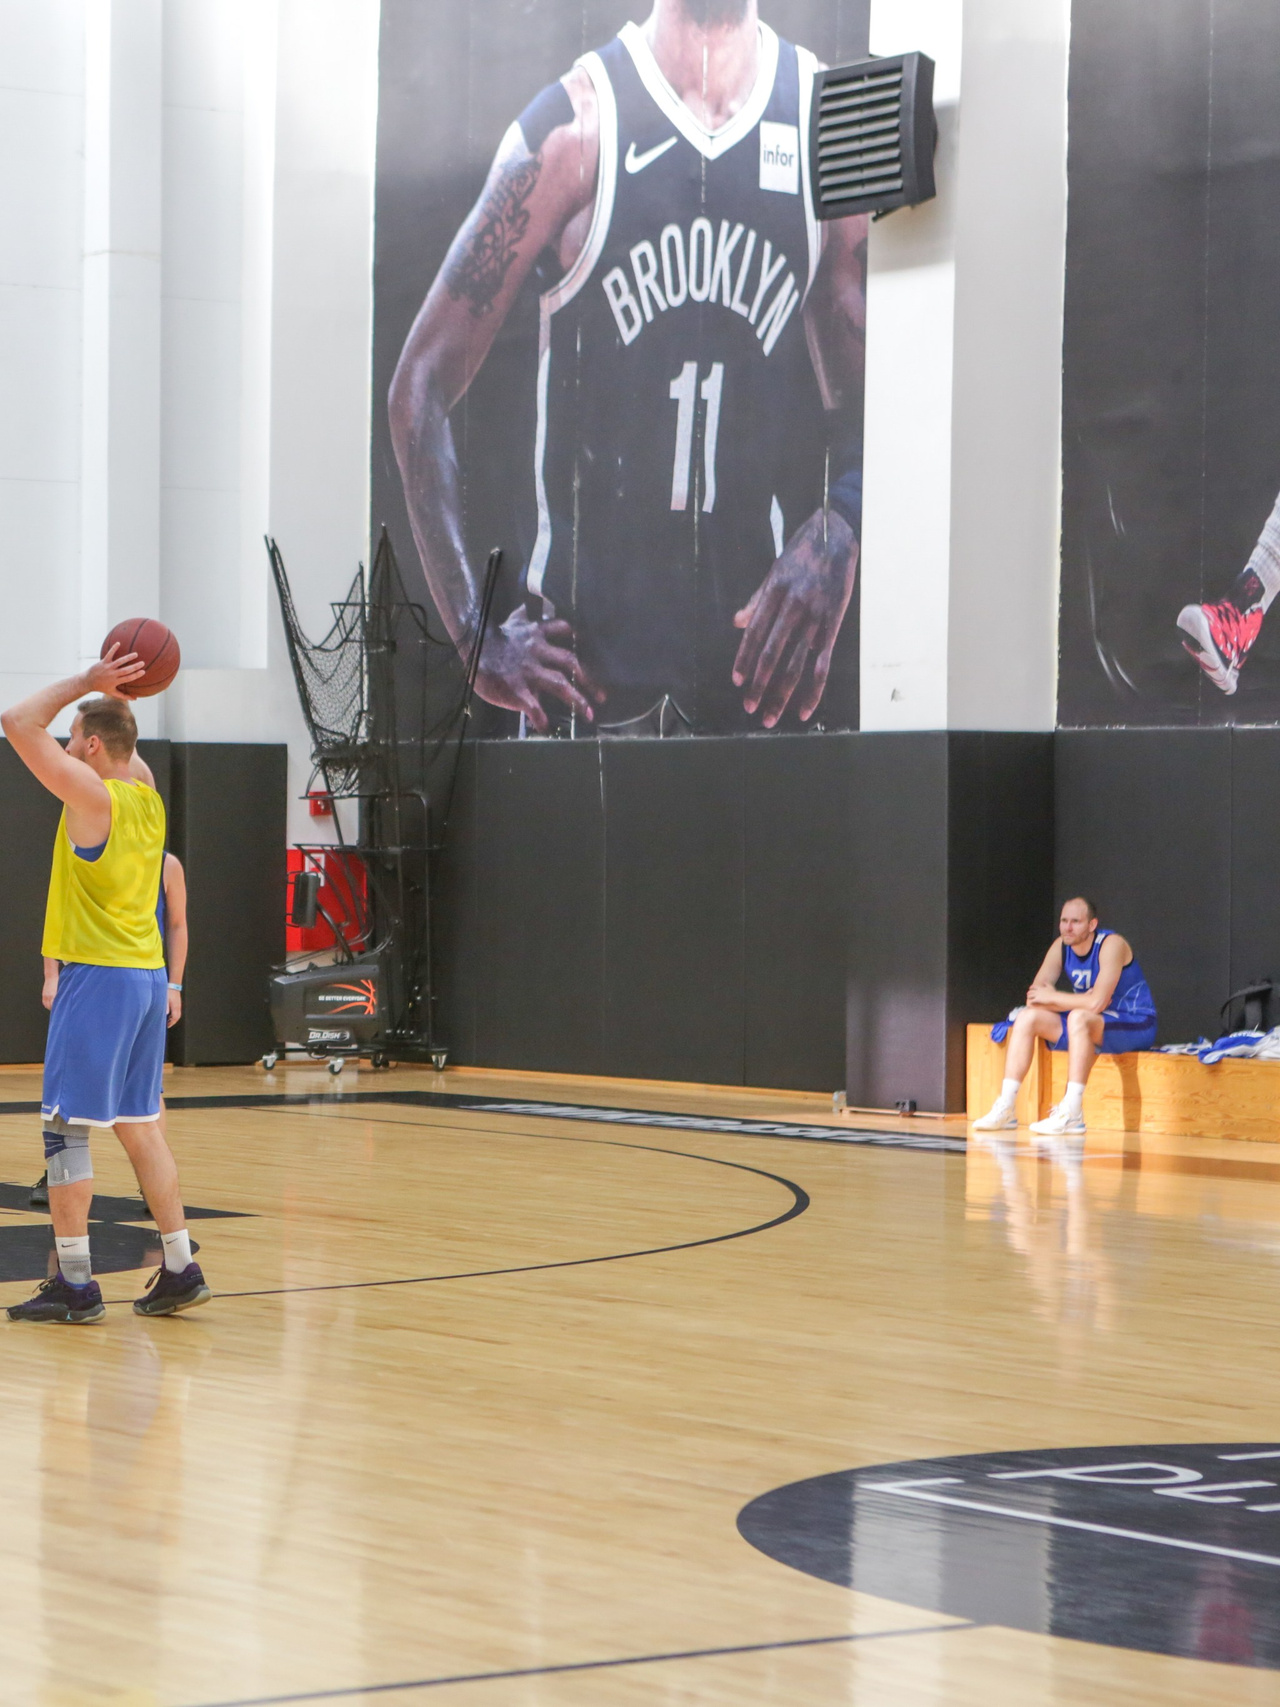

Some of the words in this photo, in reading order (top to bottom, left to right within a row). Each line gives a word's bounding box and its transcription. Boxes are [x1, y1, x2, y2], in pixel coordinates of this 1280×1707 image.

[763, 144, 794, 168] infor
[602, 217, 799, 357] BROOKLYN
[669, 361, 724, 514] 11
[1071, 969, 1092, 989] 27
